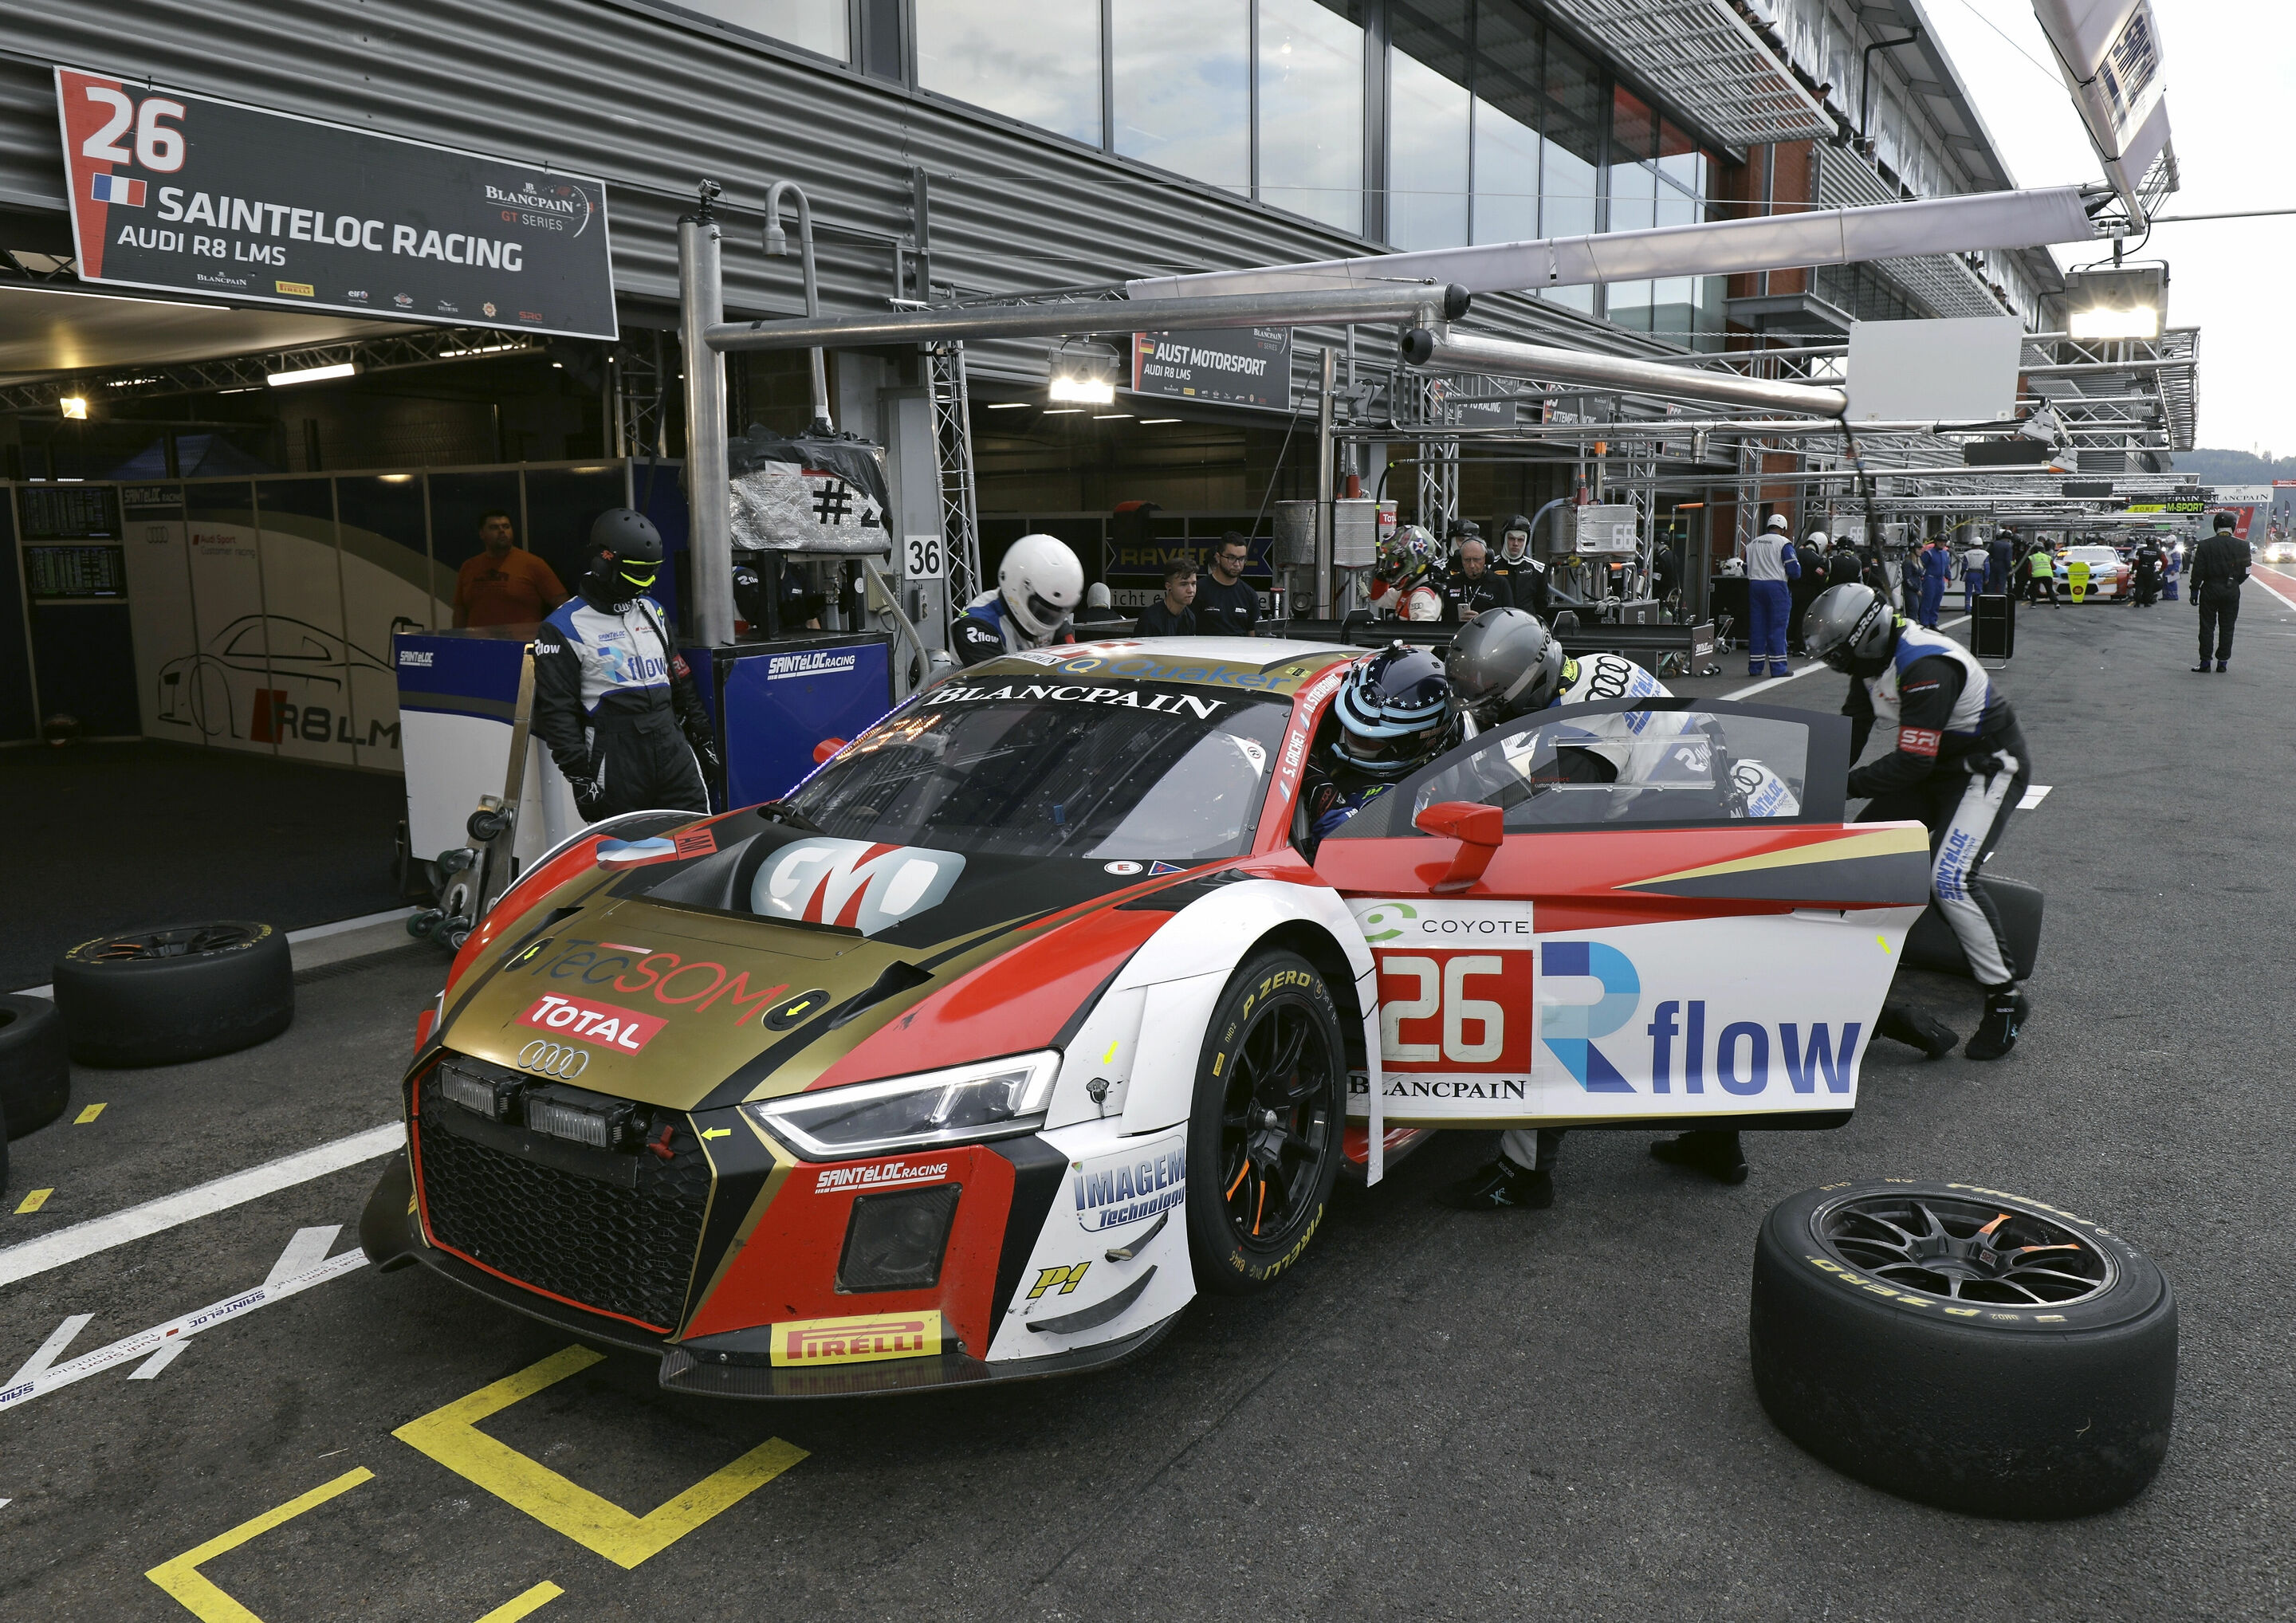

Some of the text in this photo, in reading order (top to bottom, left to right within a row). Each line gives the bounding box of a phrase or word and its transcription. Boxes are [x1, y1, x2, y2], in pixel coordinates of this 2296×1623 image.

[82, 86, 186, 172] 26
[485, 185, 574, 214] BLANCPAIN
[157, 187, 523, 272] SAINTELOC RACING
[501, 210, 563, 230] GT SERIES
[117, 225, 286, 266] AUDI R8 LMS
[197, 273, 247, 286] BLANCPAIN
[1254, 328, 1282, 340] BLANCPAIN
[1264, 343, 1278, 352] SERIES
[1144, 363, 1192, 381] AUDI R8 LMS
[1156, 342, 1267, 376] AUST MOTORSPORT
[2166, 502, 2204, 513] M-SPORT
[216, 534, 237, 545] Sport
[909, 540, 940, 575] 36
[966, 627, 999, 643] Rflow
[769, 653, 855, 674] SAINTéLOC RACING
[1109, 658, 1292, 690] Quaker
[922, 684, 1229, 720] BLANCPAIN
[1285, 729, 1306, 768] GACHET
[1117, 863, 1130, 872] E
[1936, 827, 1970, 900] SAINTéLOC
[1421, 919, 1531, 934] COYOTE
[1244, 970, 1311, 1020] P ZERO
[1379, 955, 1504, 1063] 26
[530, 996, 643, 1050] TOTAL
[1348, 1071, 1526, 1101] BLANCPAIN
[816, 1161, 948, 1190] SAINTéLOC RACING
[1075, 1149, 1186, 1212] IMAGEM
[1098, 1185, 1186, 1227] Technology
[1263, 1202, 1323, 1281] PIRELLI
[1810, 1258, 1982, 1318] P ZERO
[44, 1333, 159, 1380] Team Sainteloc
[78, 1335, 161, 1371] Audi Sport
[787, 1320, 925, 1360] PIRELLI
